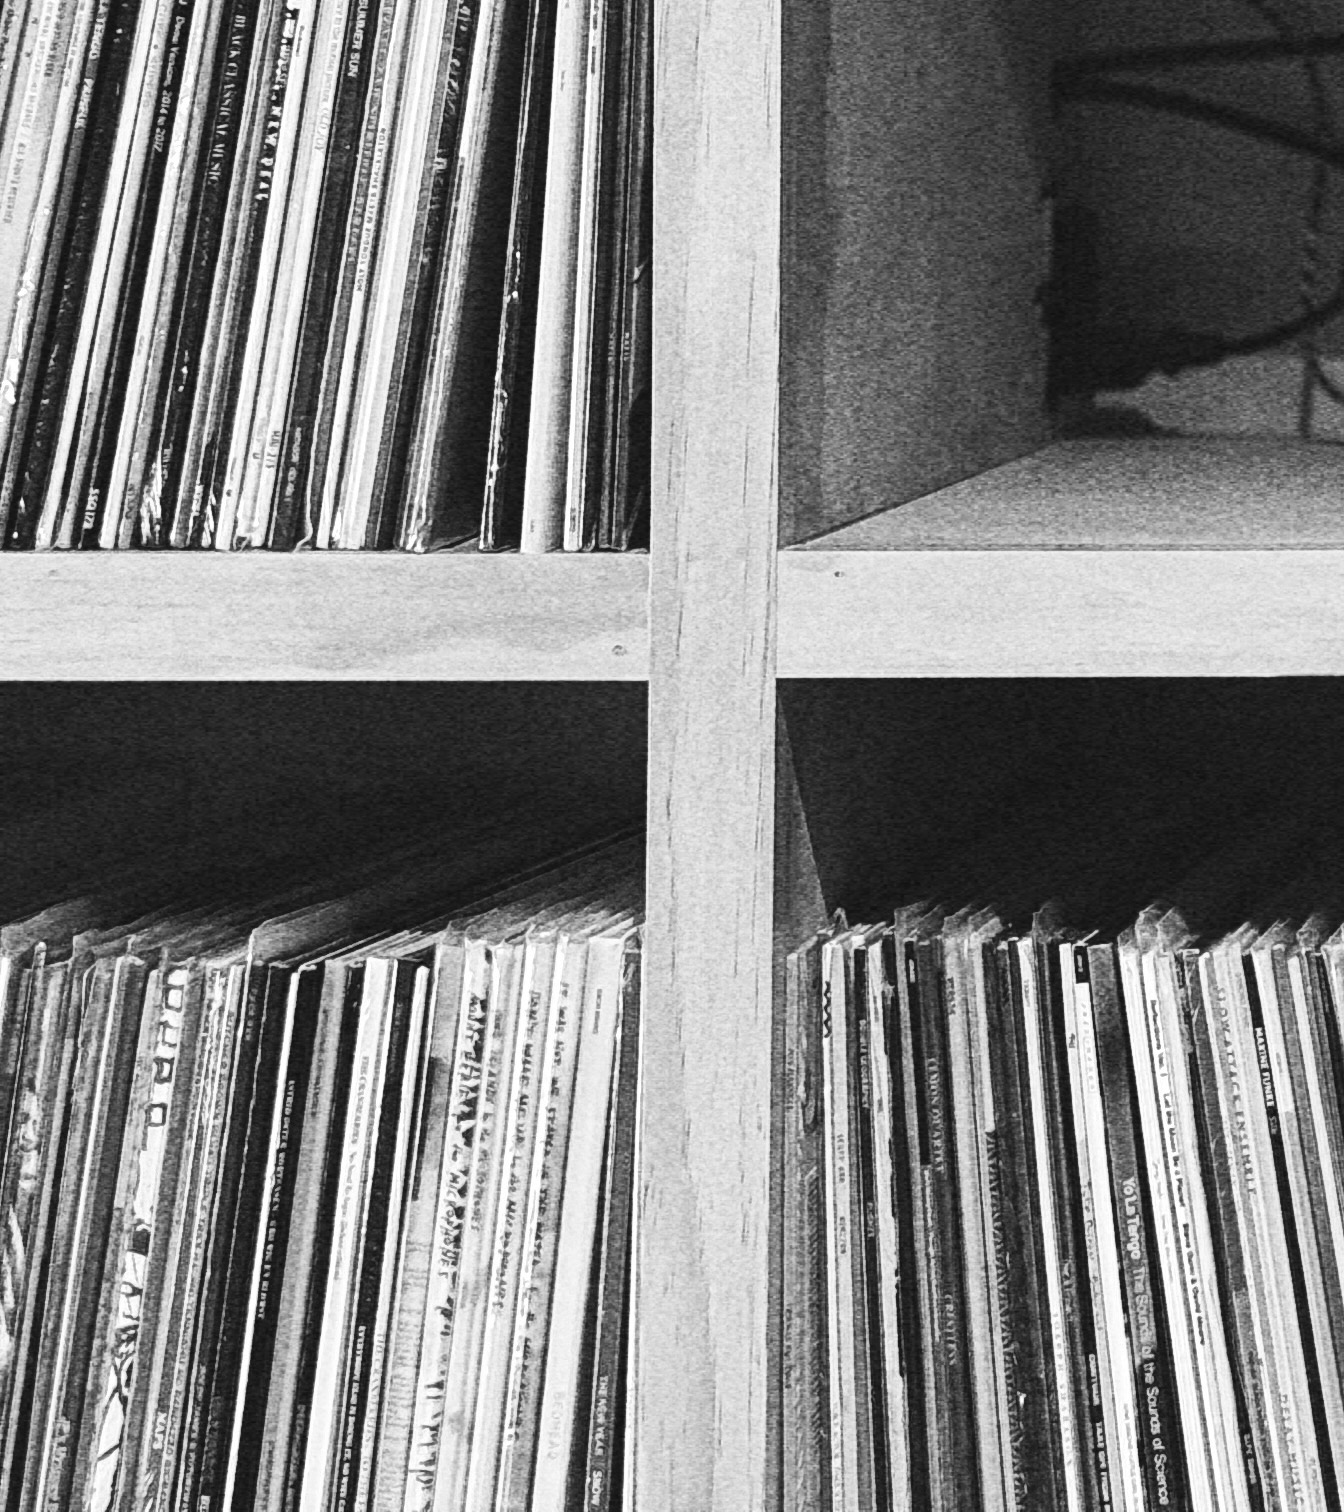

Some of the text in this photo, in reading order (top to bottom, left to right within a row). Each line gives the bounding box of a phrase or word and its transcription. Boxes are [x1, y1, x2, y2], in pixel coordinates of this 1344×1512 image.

[346, 51, 361, 77] SUN
[159, 88, 173, 115] 2014
[1254, 1026, 1274, 1107] MAXINE FUNKE
[1162, 1093, 1173, 1108] Let
[1165, 1110, 1175, 1126] the
[1121, 1176, 1171, 1505] Yo La Tengo The Sounds of the Sounds of Science
[597, 1374, 609, 1397] THE
[151, 1411, 167, 1450] MAPS
[589, 1469, 602, 1506] SNOW
